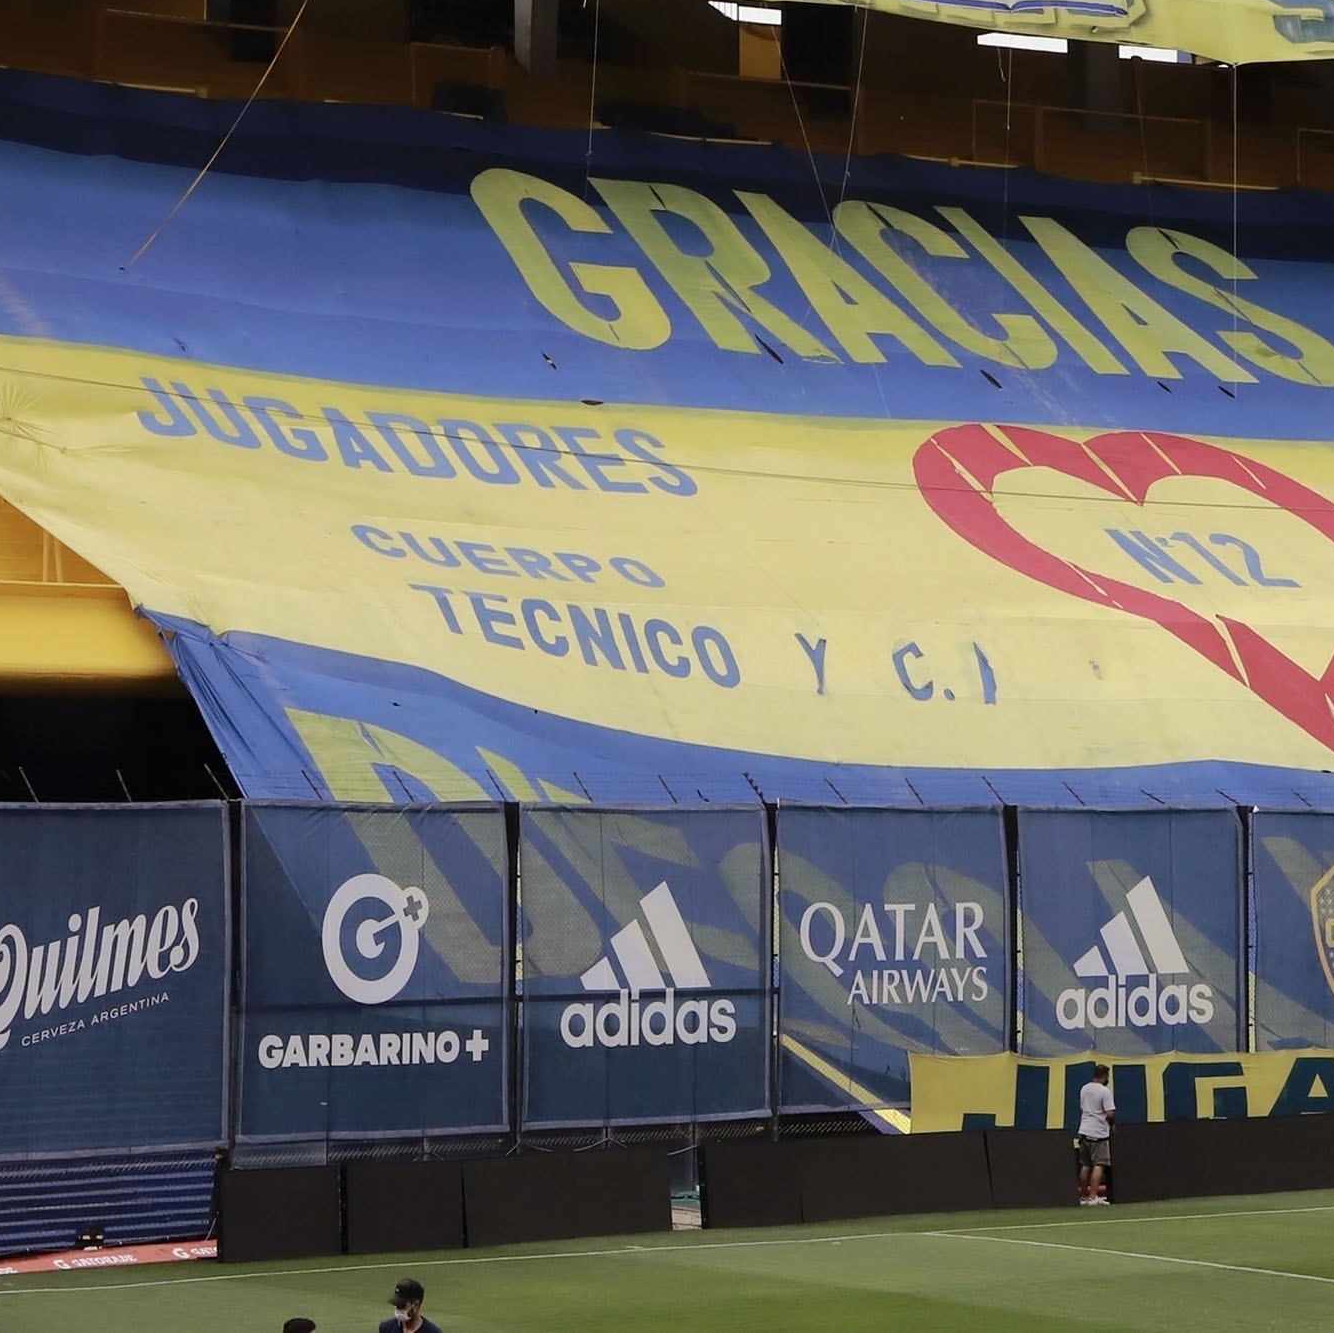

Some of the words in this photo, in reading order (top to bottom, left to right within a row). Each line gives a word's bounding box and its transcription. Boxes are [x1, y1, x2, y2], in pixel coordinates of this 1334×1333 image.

[134, 376, 700, 497] JUGADORES
[351, 523, 667, 588] CUERPO
[407, 583, 741, 689] TECNICO
[794, 632, 827, 696] Y
[799, 901, 987, 977] QATAR
[847, 965, 988, 1005] AIRWAYS
[1056, 974, 1214, 1029] adidas
[21, 1019, 85, 1047] CERVEZA
[90, 992, 170, 1026] ARGENTINA
[560, 988, 737, 1048] adidas
